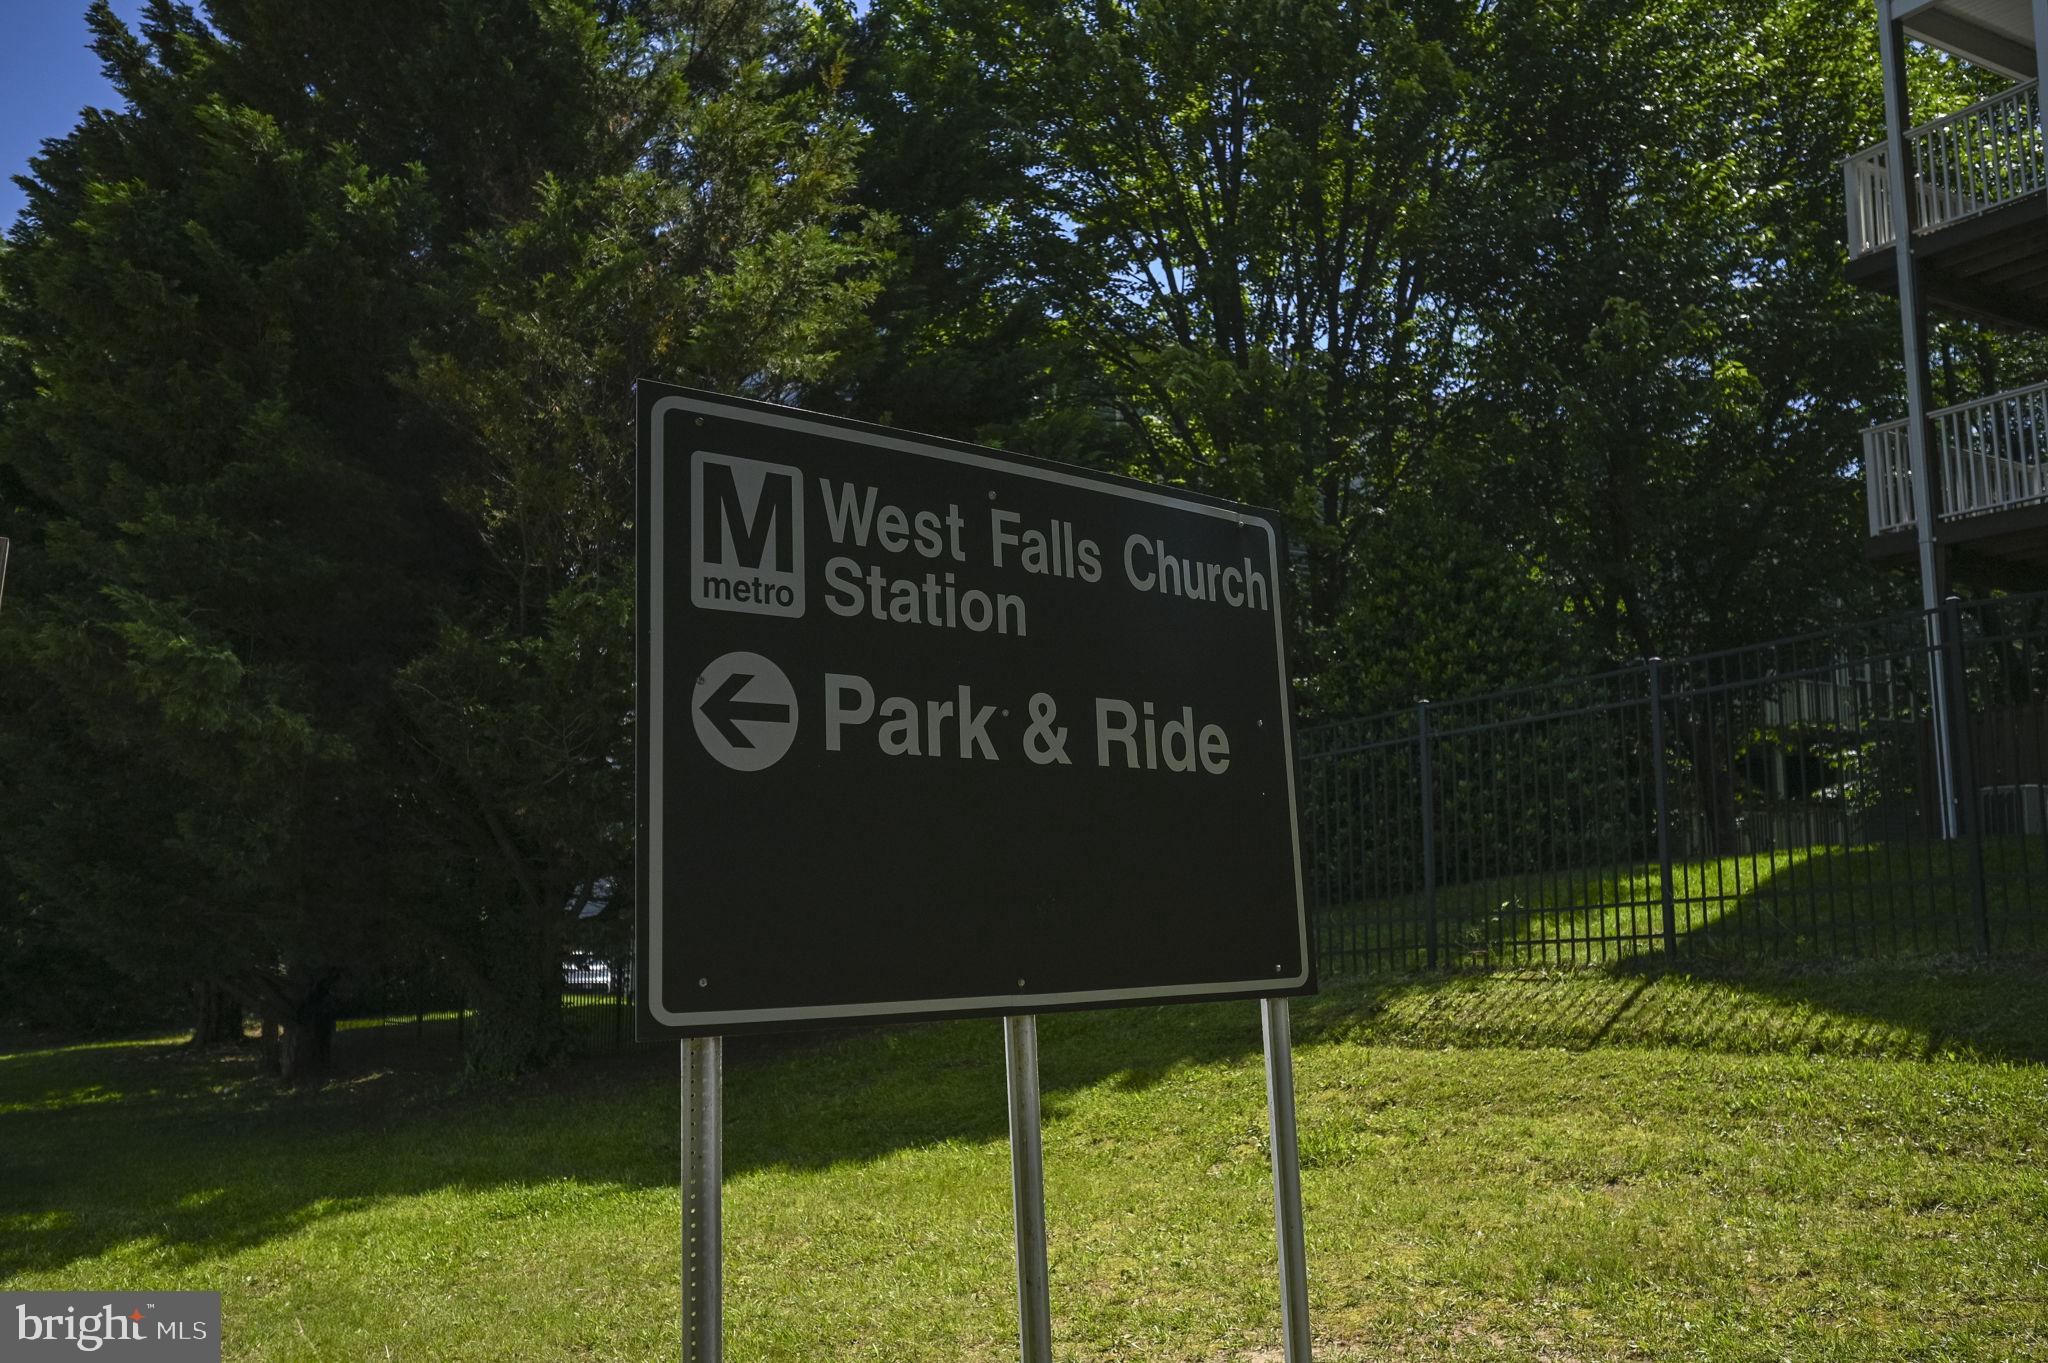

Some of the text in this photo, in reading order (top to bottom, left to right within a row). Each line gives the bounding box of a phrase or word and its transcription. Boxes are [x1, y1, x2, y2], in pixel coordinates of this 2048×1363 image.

[818, 477, 1269, 611] West Falls Church
[703, 573, 795, 608] metro
[824, 556, 1027, 637] Station
[825, 673, 1231, 775] Park & Ride
